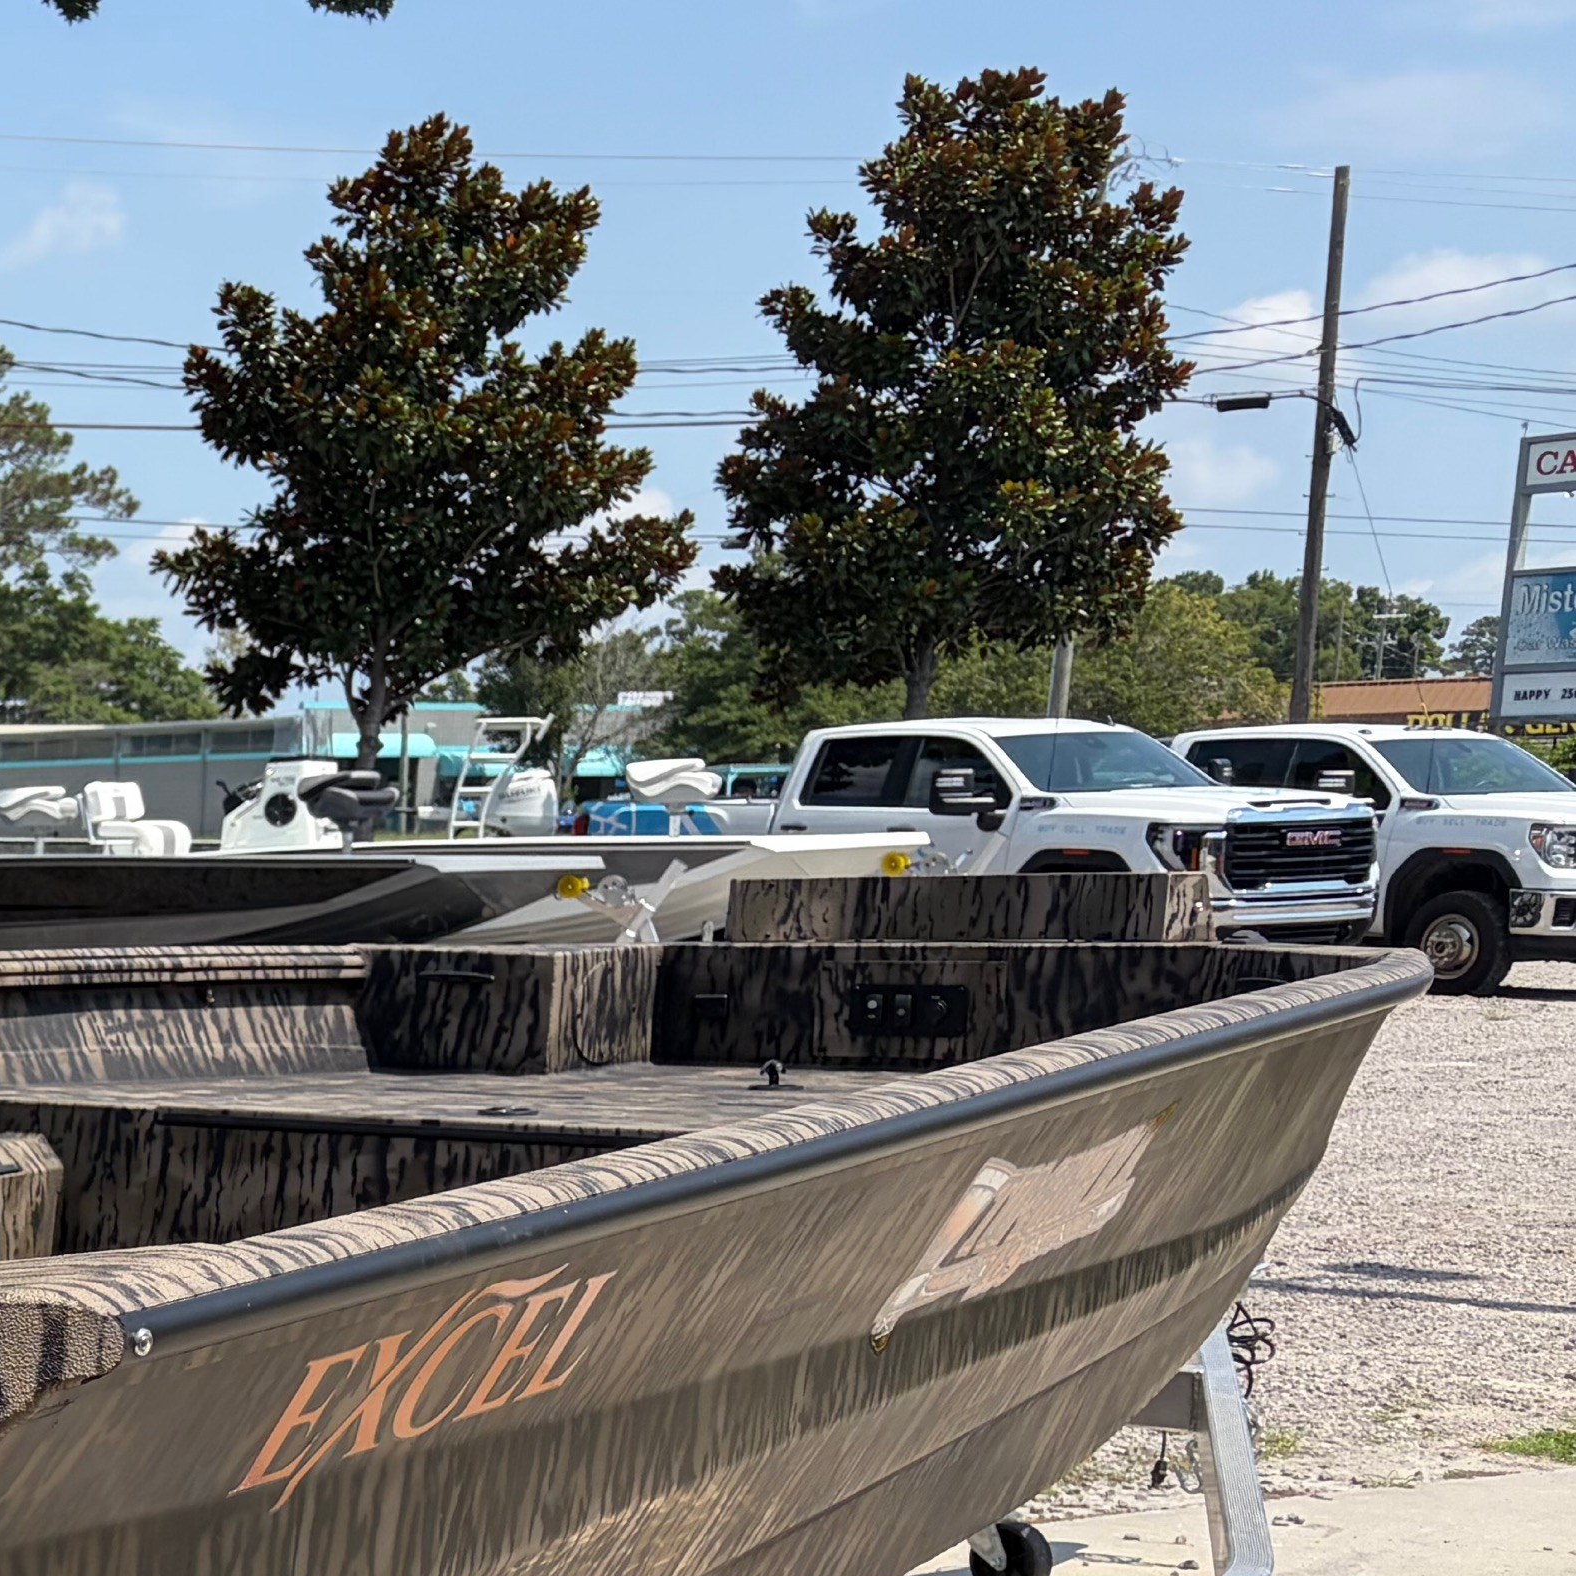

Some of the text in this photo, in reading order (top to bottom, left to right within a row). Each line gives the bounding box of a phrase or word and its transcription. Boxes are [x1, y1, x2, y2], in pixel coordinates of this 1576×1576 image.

[1518, 583, 1576, 615] Mist
[1514, 688, 1576, 701] HAPPY 25
[226, 1262, 618, 1514] EXCEL
